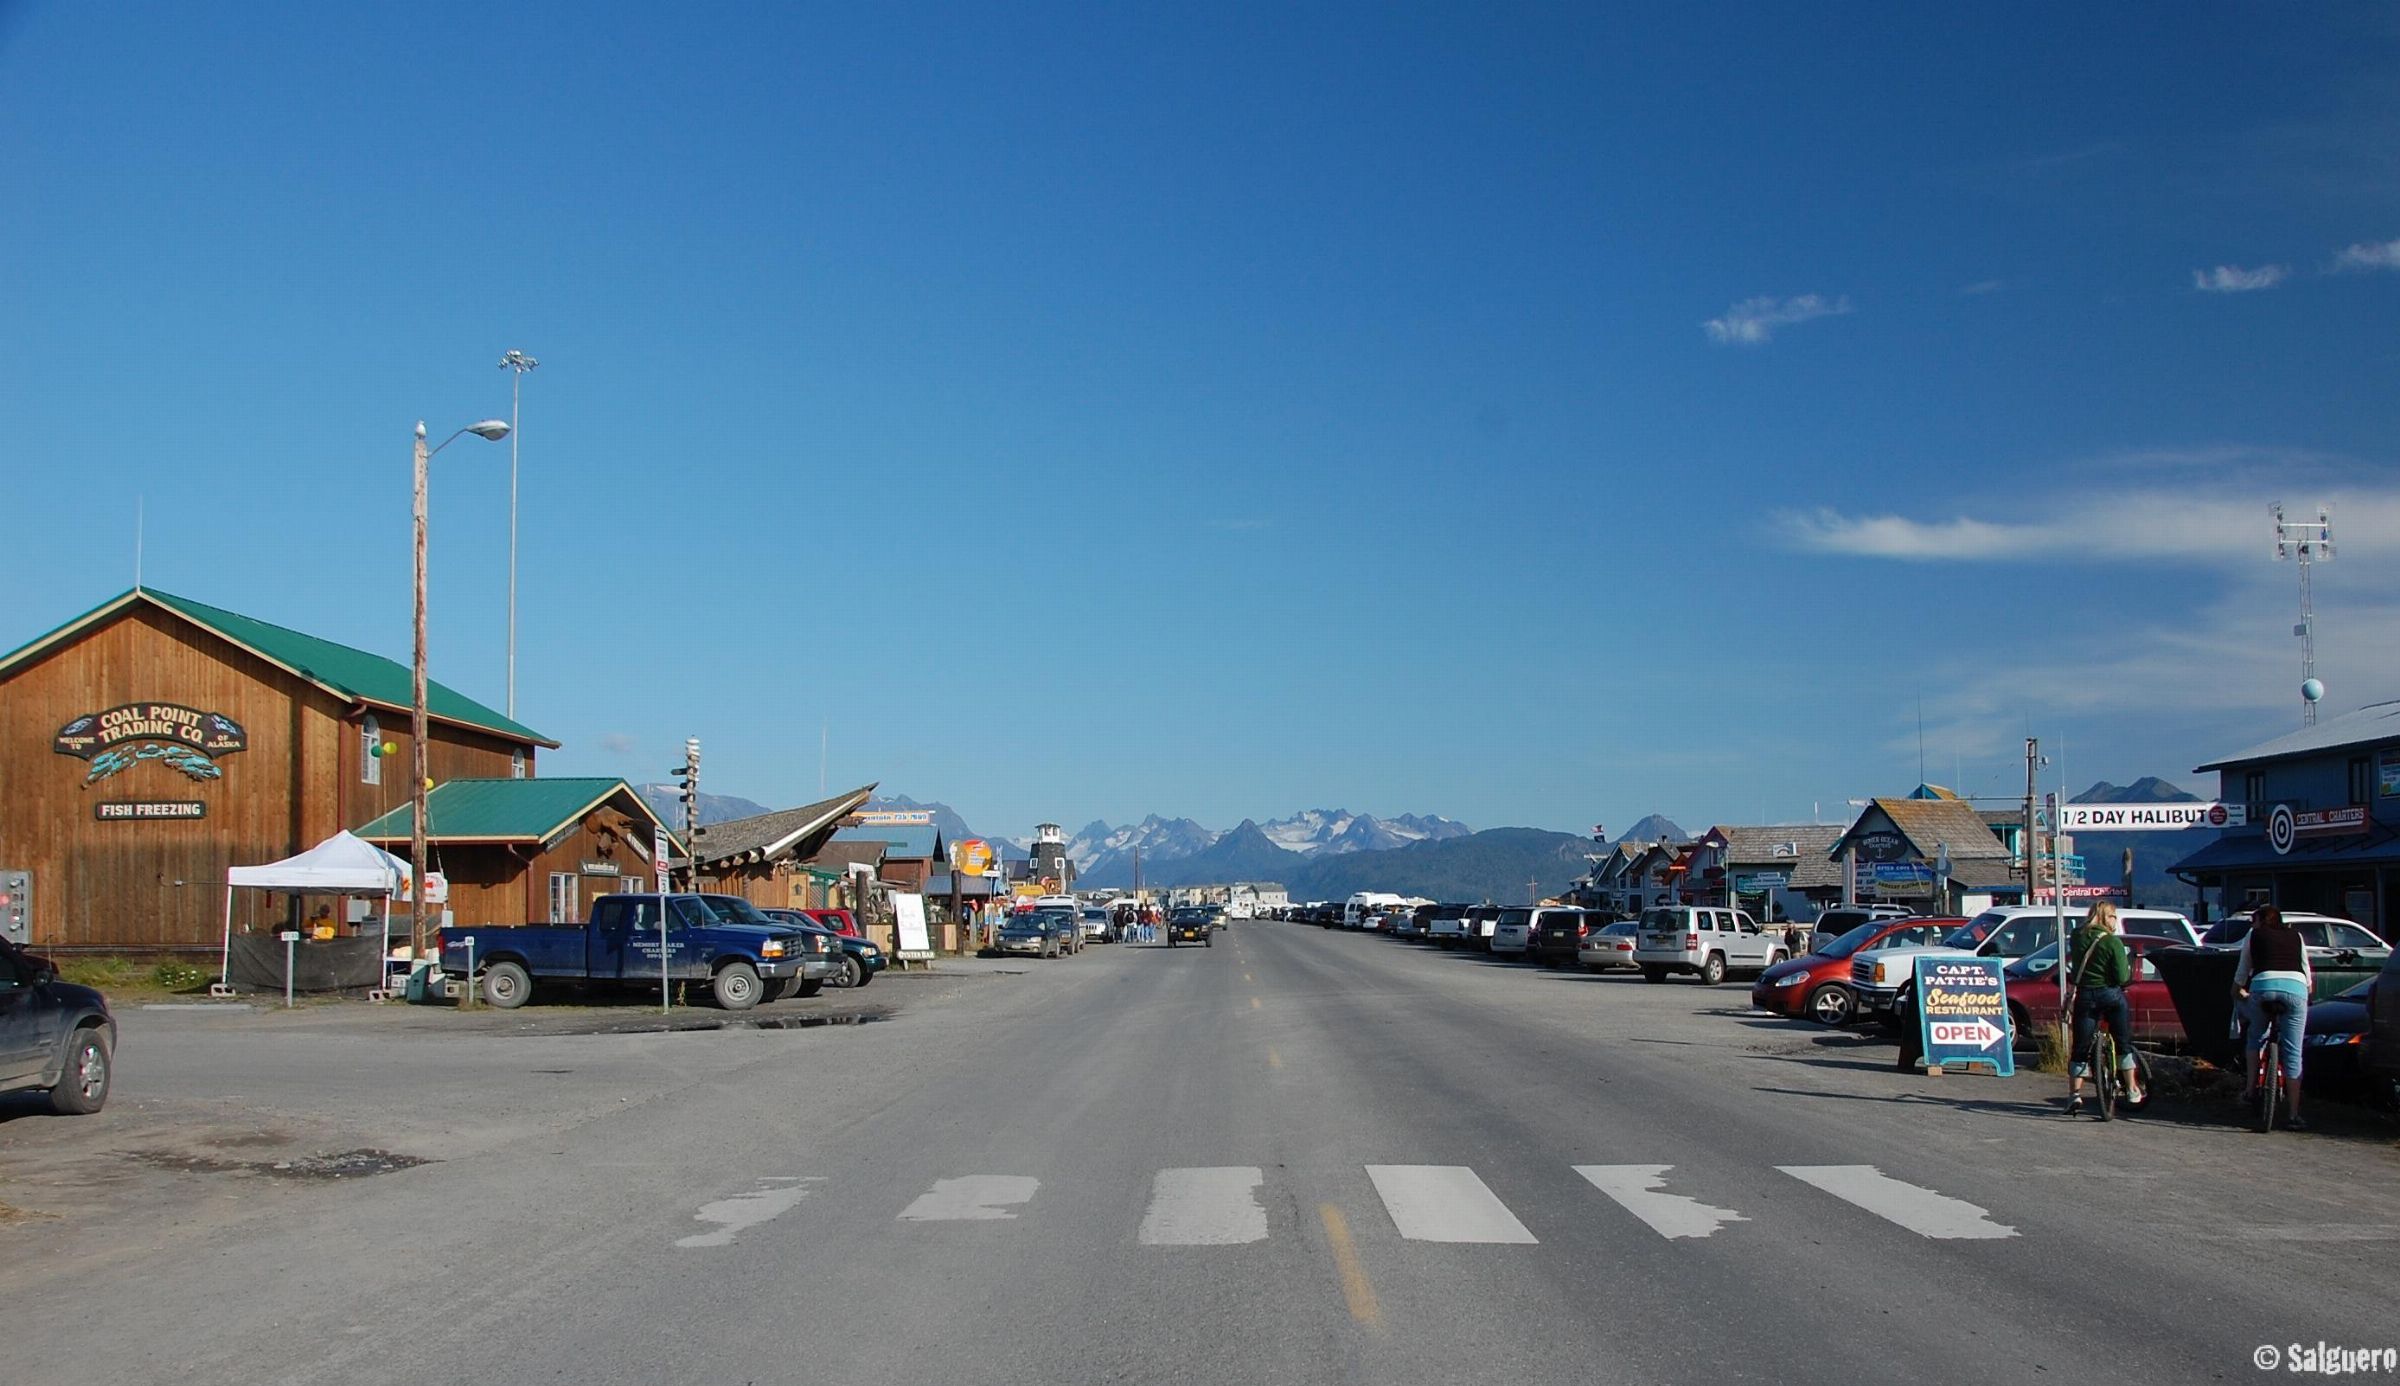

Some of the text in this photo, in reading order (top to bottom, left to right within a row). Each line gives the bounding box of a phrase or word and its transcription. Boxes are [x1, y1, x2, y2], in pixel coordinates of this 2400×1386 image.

[101, 706, 202, 728] COAL POINT
[98, 720, 173, 744] TRADING
[59, 736, 95, 744] WELCOME
[207, 740, 241, 748] ALASKA
[101, 804, 200, 816] FISH FREEZING
[2062, 810, 2087, 826] 1/2
[2093, 810, 2126, 824] DAY
[2131, 809, 2207, 824] HALIBUT
[2296, 807, 2364, 825] CENTRAL CHARTERS
[2061, 887, 2091, 897] Central
[2093, 887, 2128, 897] Charters
[898, 951, 935, 959] OYSTER BAR
[1936, 965, 1985, 975] CAPT.
[1924, 976, 1998, 986] PATTIE'S
[1926, 988, 2002, 1007] Seafood
[1925, 1006, 2003, 1015] RESTAURANT
[1934, 1025, 1992, 1041] OPEN
